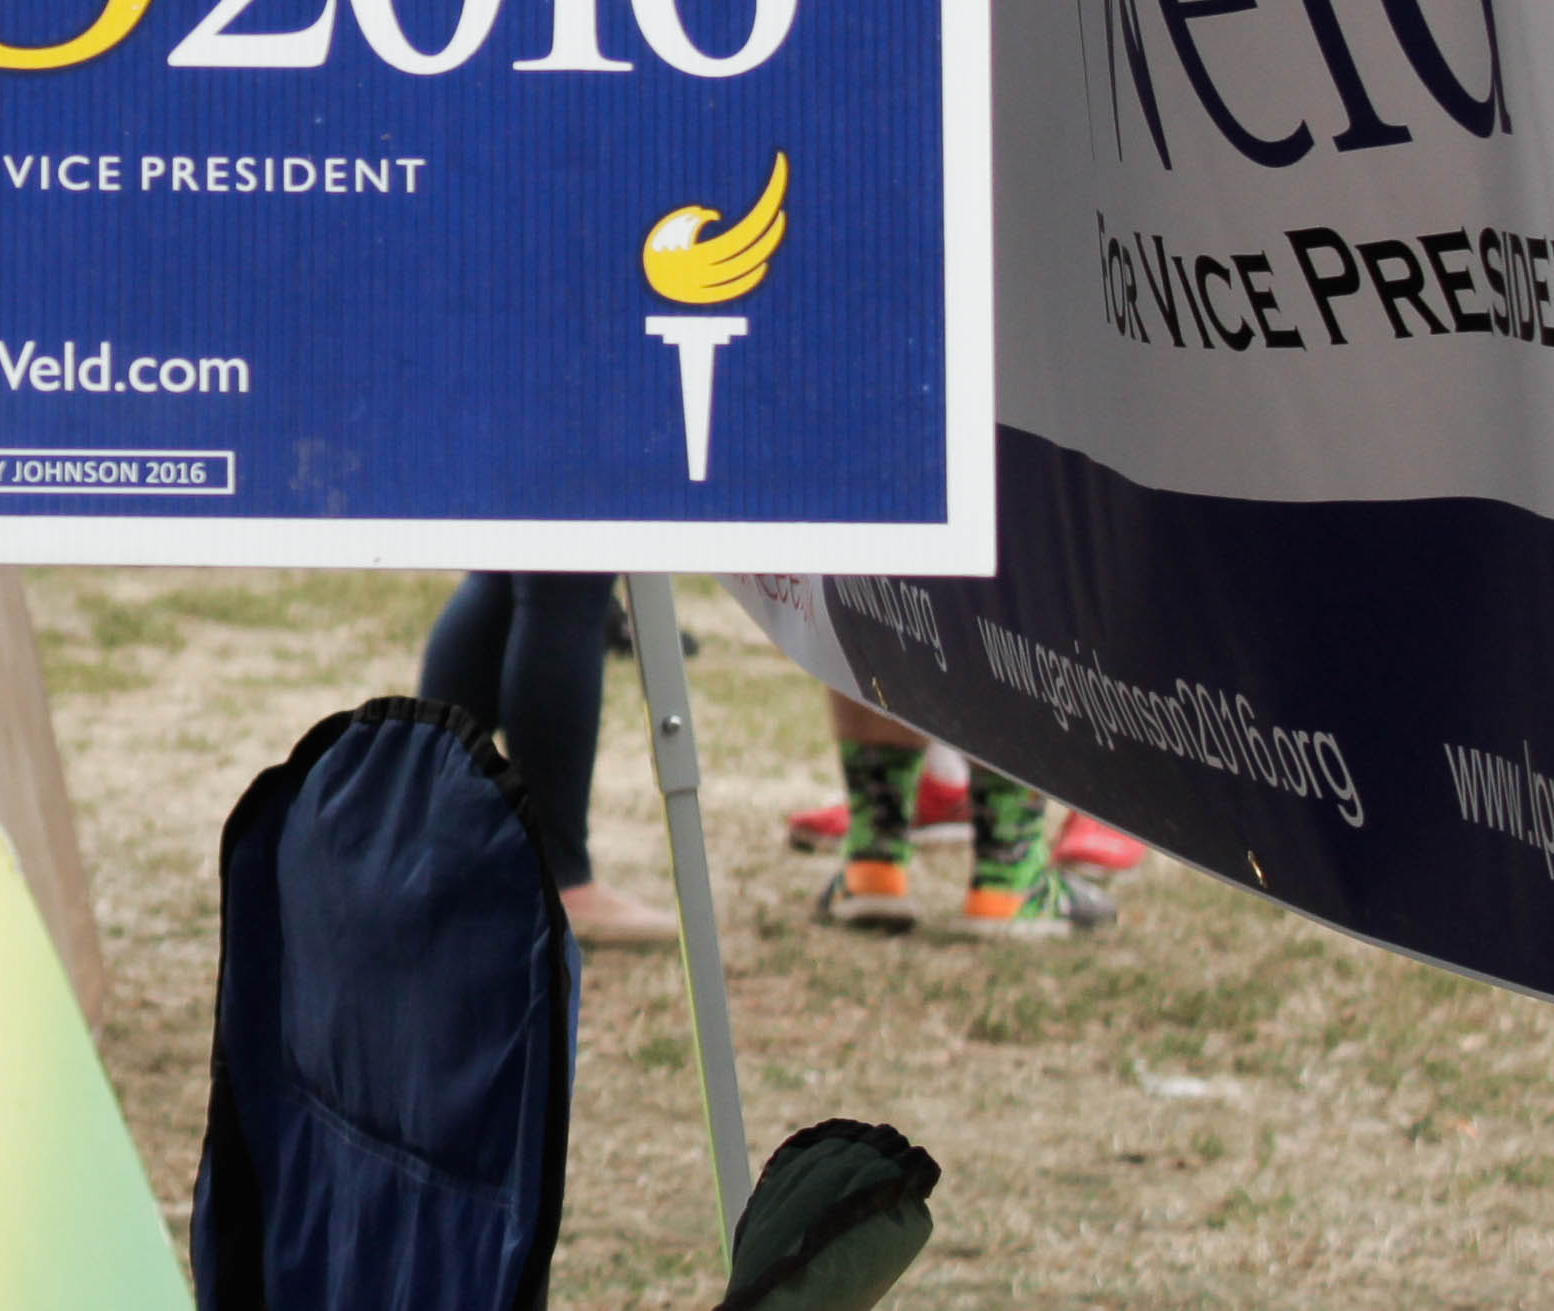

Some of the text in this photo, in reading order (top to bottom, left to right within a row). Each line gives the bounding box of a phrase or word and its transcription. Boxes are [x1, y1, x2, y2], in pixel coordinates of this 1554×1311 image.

[141, 156, 425, 193] PRESIDENT
[1134, 231, 1307, 351] VICE
[1283, 226, 1554, 348] PRESIDE
[12, 460, 139, 483] JOHNSON
[145, 462, 207, 484] 2016
[1443, 739, 1554, 881] www.lp
